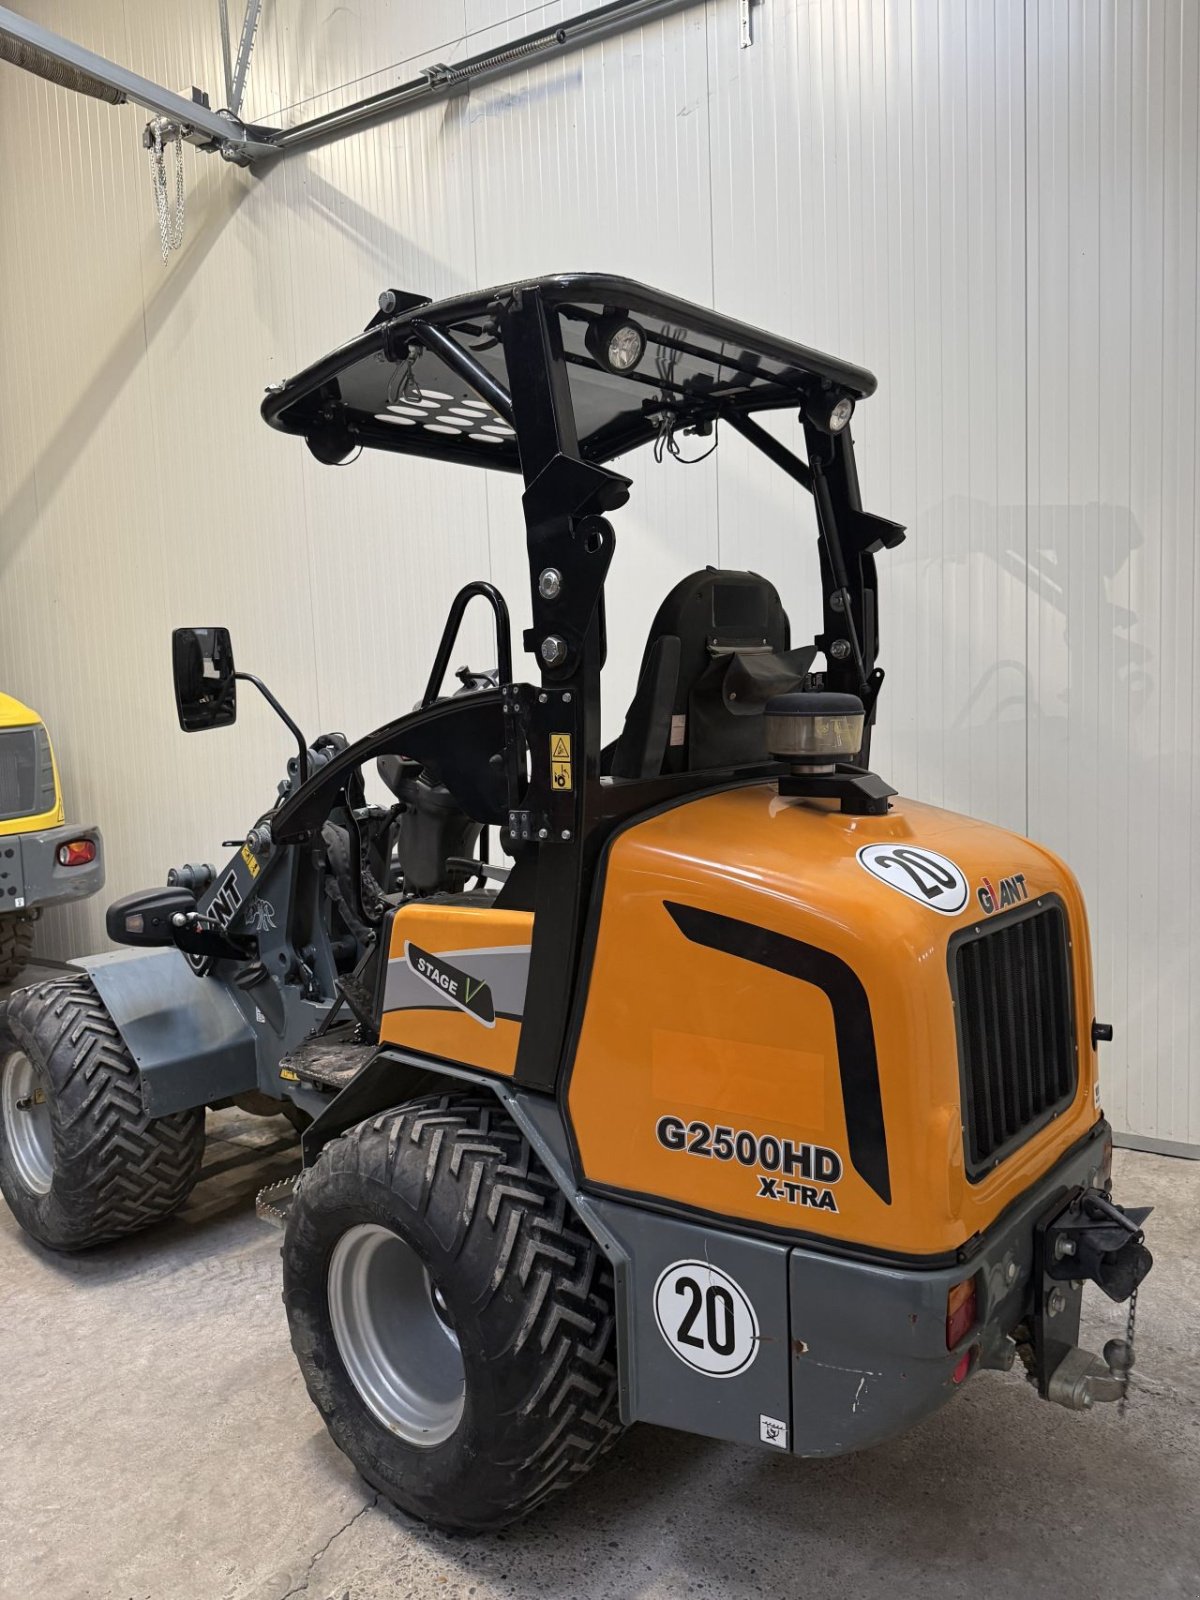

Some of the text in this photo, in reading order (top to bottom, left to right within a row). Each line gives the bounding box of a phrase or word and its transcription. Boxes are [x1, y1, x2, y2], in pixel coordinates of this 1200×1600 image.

[874, 848, 957, 900] 20
[417, 957, 487, 1004] STAGE V
[655, 1115, 843, 1184] G2500HD
[757, 1174, 839, 1214] X-TRA
[674, 1276, 736, 1356] 20
